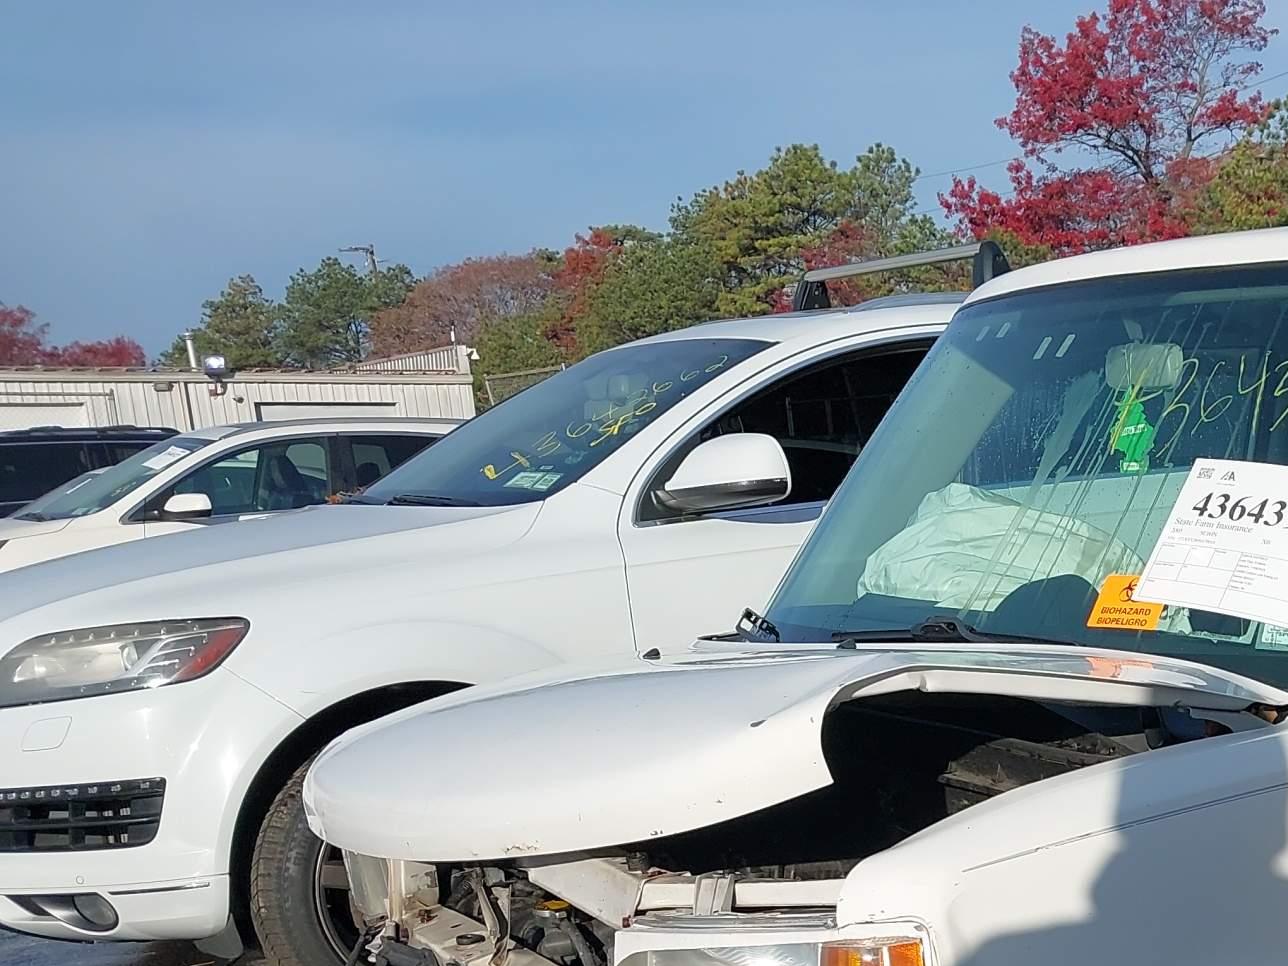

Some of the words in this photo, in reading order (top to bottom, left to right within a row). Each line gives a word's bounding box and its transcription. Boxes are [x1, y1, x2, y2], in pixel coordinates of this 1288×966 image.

[1174, 517, 1194, 526] State
[1194, 518, 1215, 528] Farm
[1216, 521, 1254, 533] Insurance
[1100, 606, 1152, 616] BIOHAZARD
[1096, 617, 1148, 627] BIOPELIGRO
